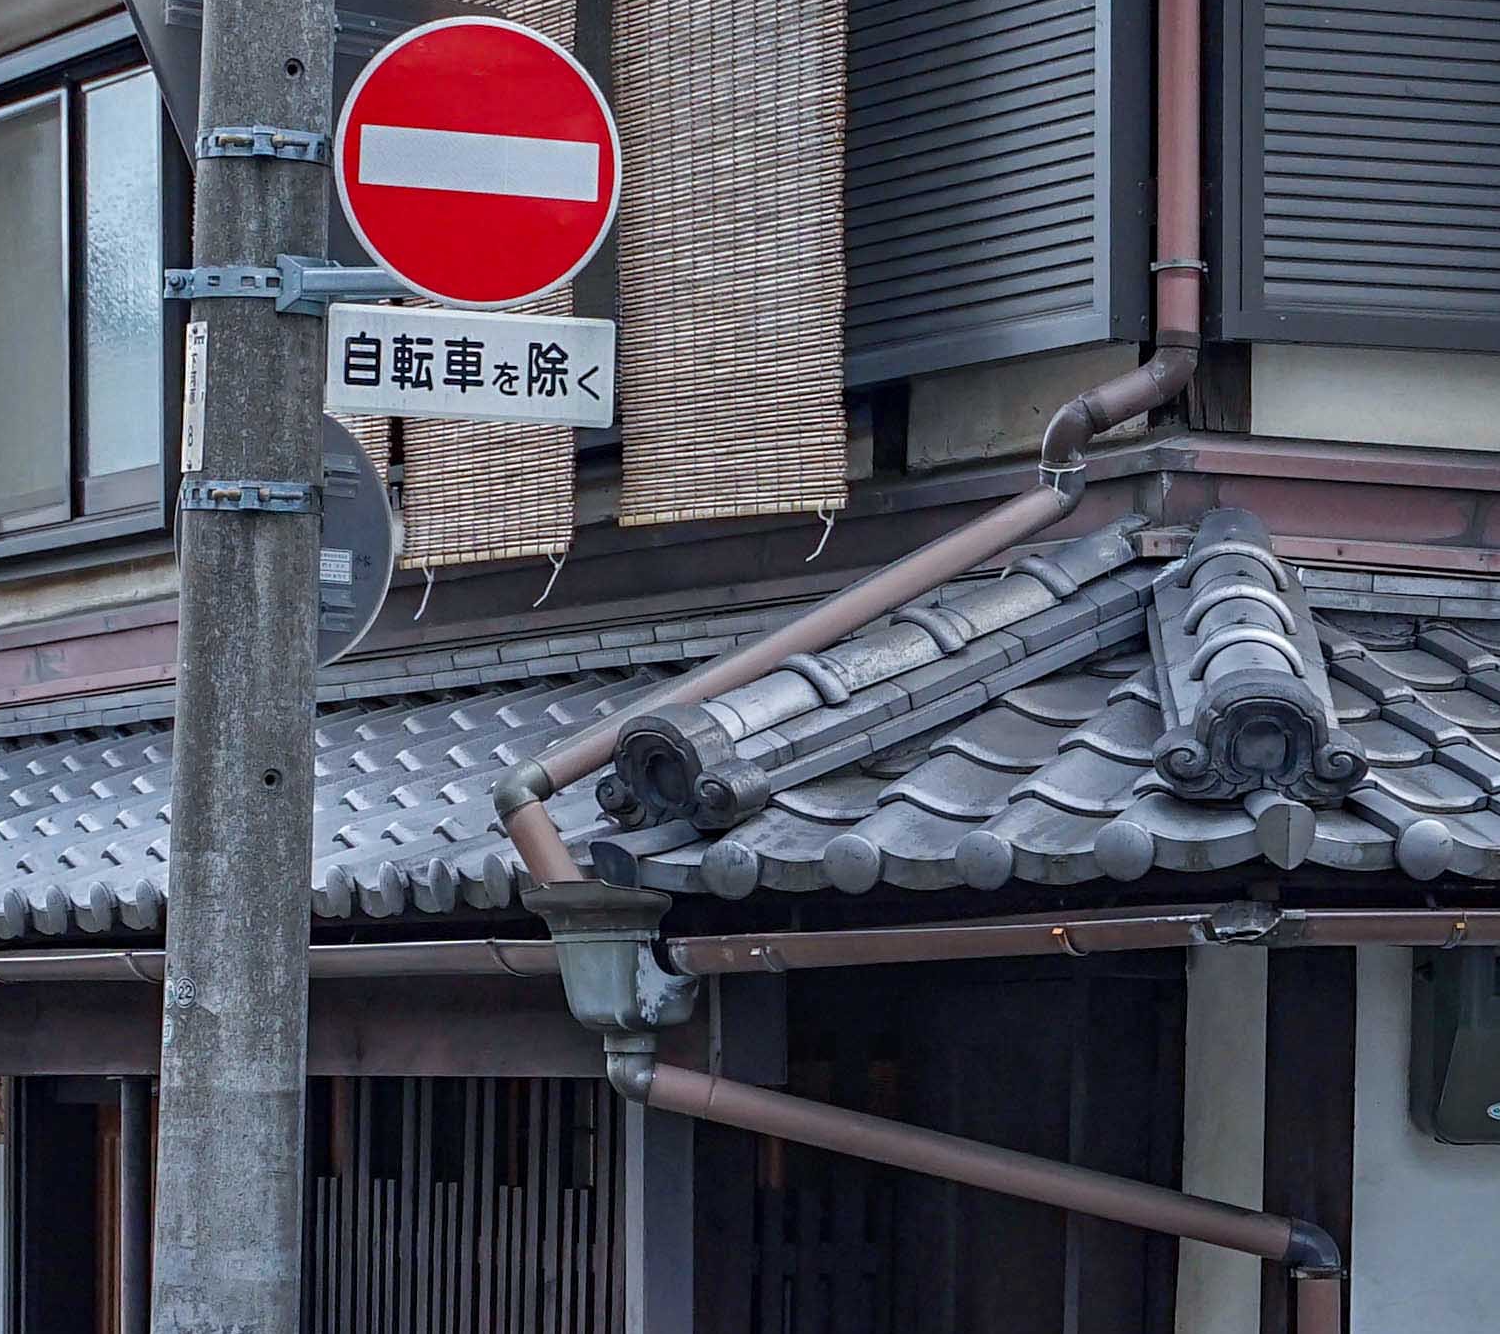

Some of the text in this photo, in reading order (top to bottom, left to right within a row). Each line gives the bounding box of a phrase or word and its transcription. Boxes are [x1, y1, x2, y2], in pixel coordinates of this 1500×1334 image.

[344, 331, 601, 400] 自転車を除く
[179, 985, 193, 1000] 22
